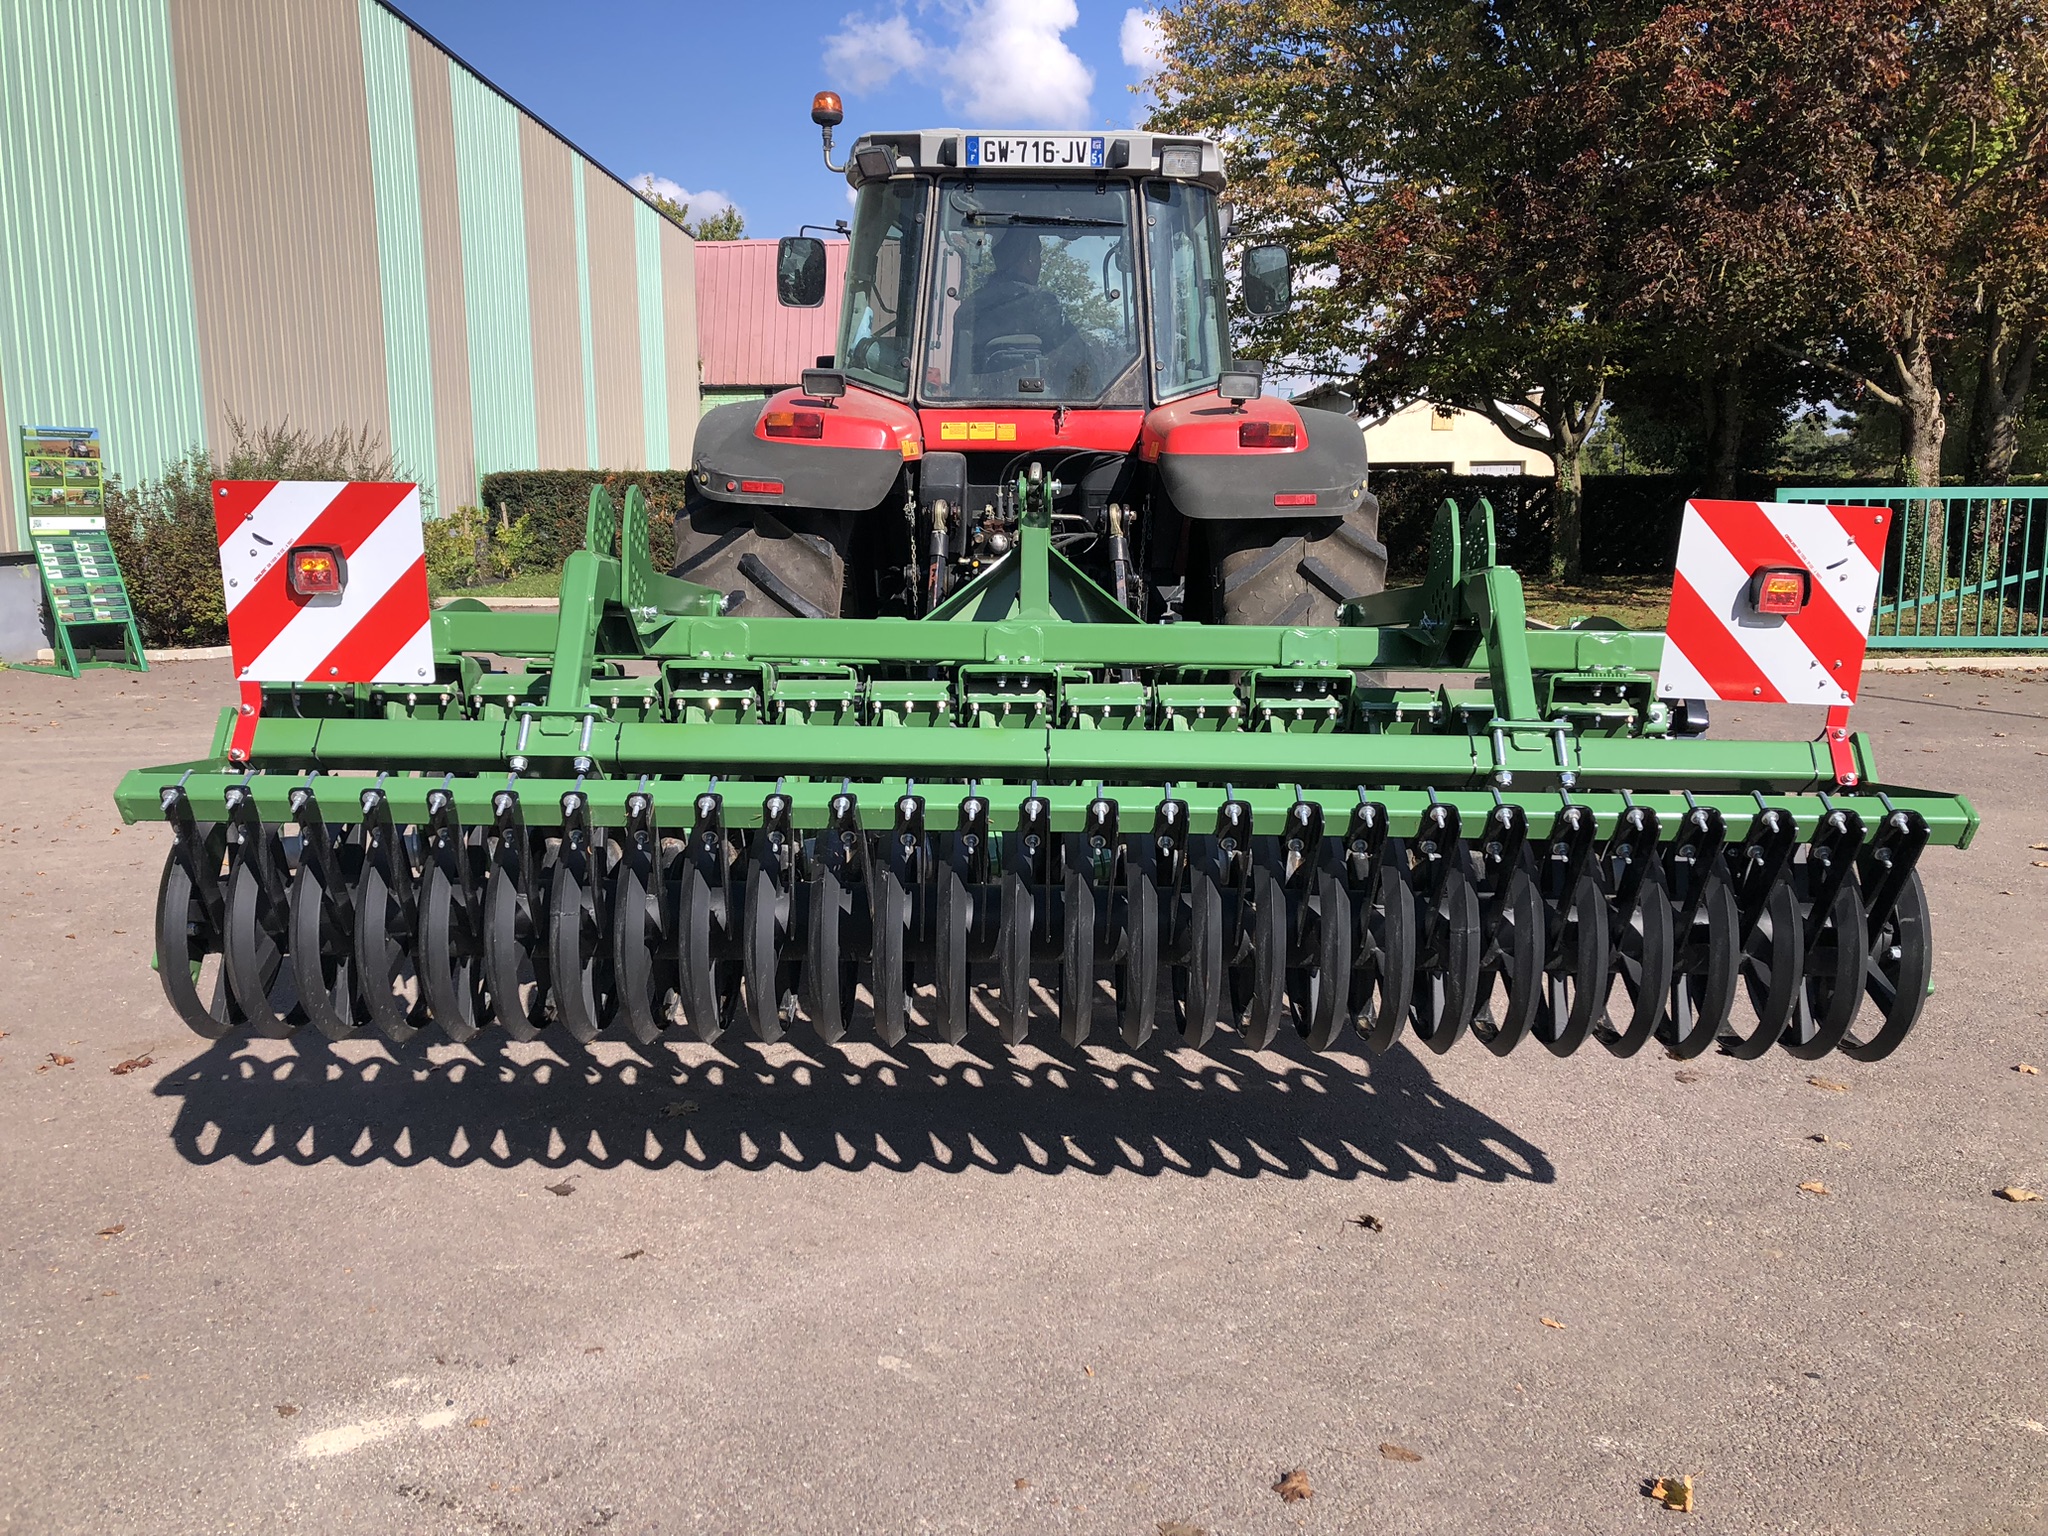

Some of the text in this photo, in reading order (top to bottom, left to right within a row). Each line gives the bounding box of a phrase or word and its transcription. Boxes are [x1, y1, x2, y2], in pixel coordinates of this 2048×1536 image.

[984, 140, 1087, 163] GW-716-JV
[970, 154, 975, 162] F
[1091, 153, 1102, 164] 51
